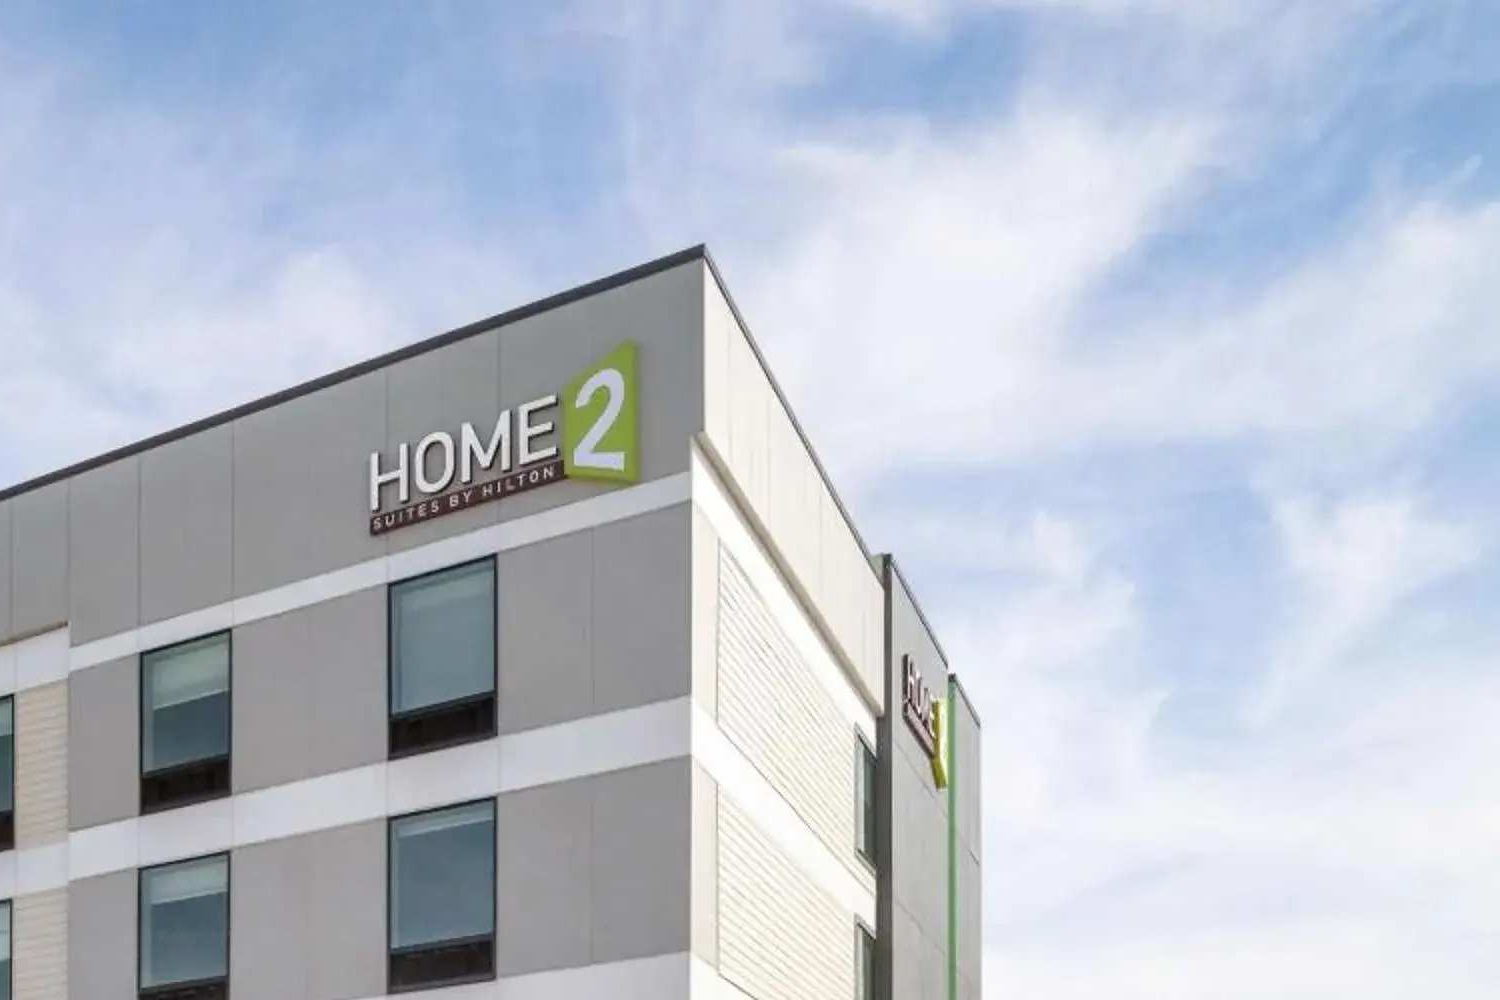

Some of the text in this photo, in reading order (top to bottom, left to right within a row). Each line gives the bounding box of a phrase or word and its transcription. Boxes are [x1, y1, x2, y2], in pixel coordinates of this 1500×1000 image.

[370, 368, 625, 512] HOME 2
[373, 466, 555, 530] SUITES BY HILTON
